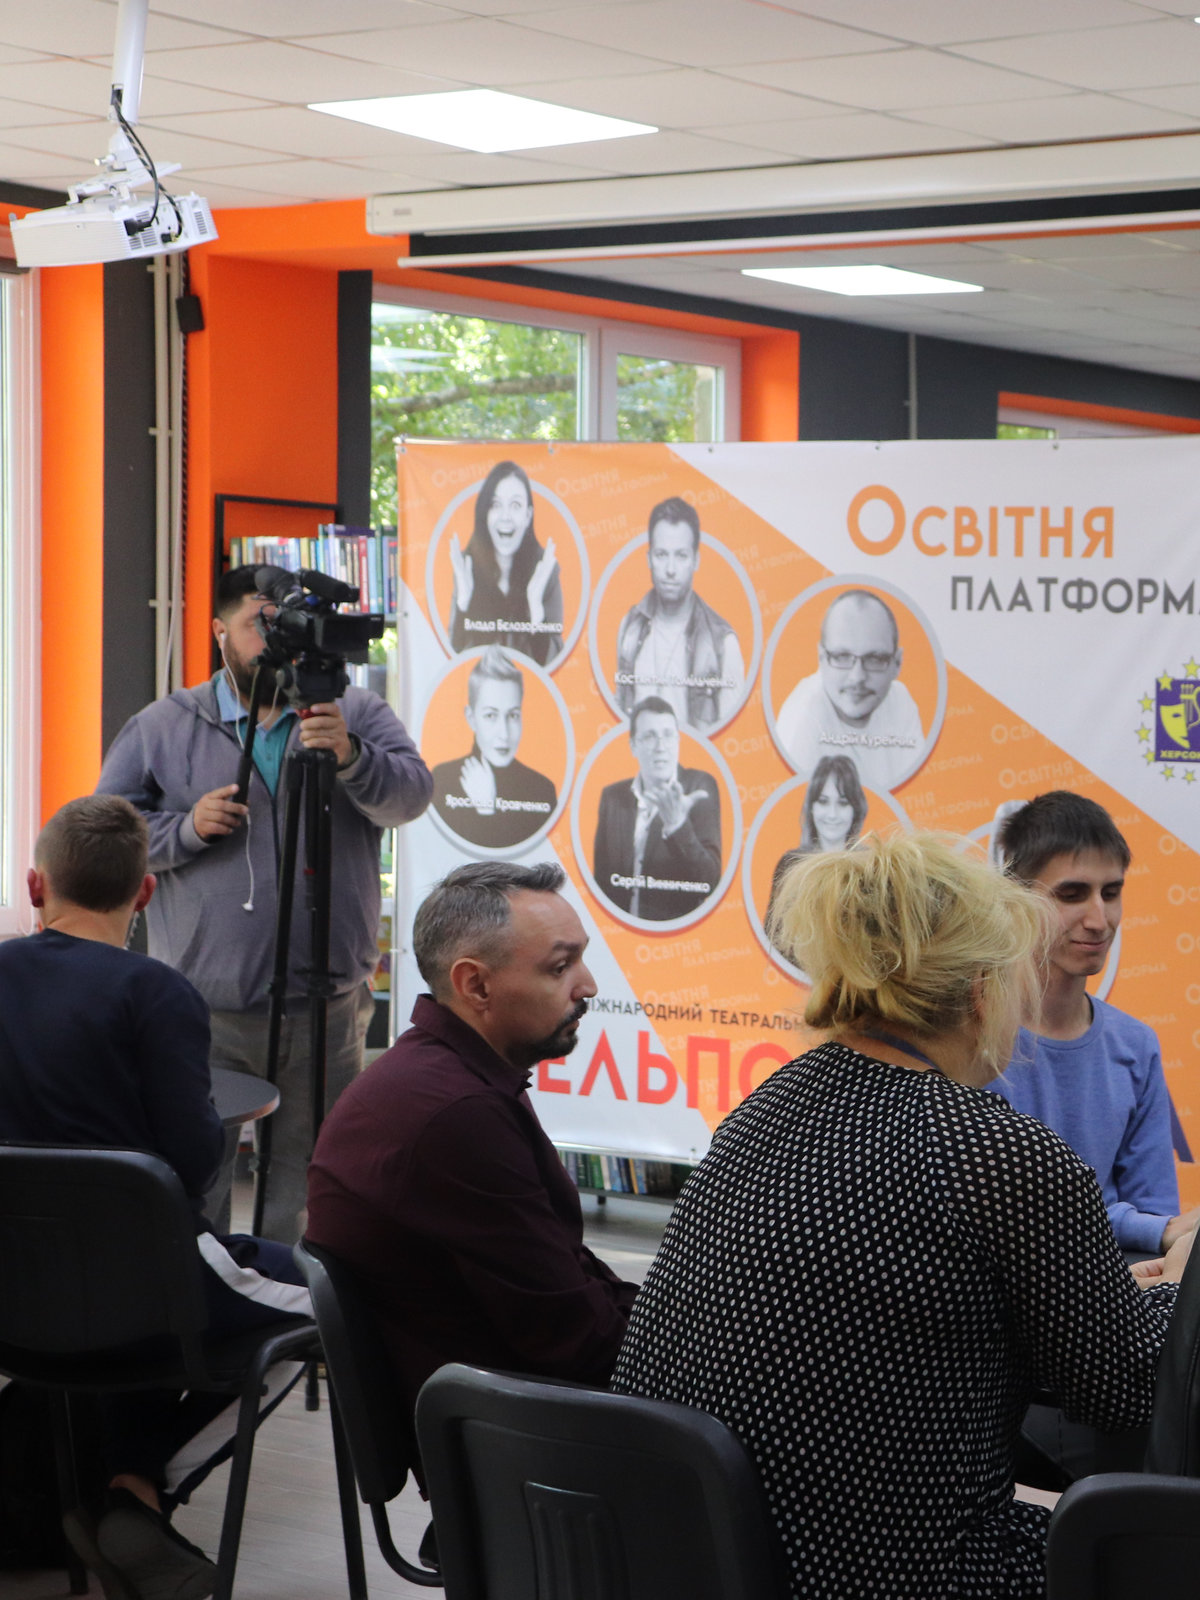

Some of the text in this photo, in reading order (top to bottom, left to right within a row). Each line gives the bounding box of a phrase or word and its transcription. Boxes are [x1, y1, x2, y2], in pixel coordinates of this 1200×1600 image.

[847, 484, 1115, 559] ОСВІТНЯ
[464, 618, 496, 632] Влада
[820, 731, 859, 747] Андрій
[998, 760, 1074, 790] ОСВІТНЯ
[495, 797, 551, 813] Кравченко
[610, 873, 646, 889] Сергій
[588, 998, 702, 1022] ІЖНАРОДНИЙ
